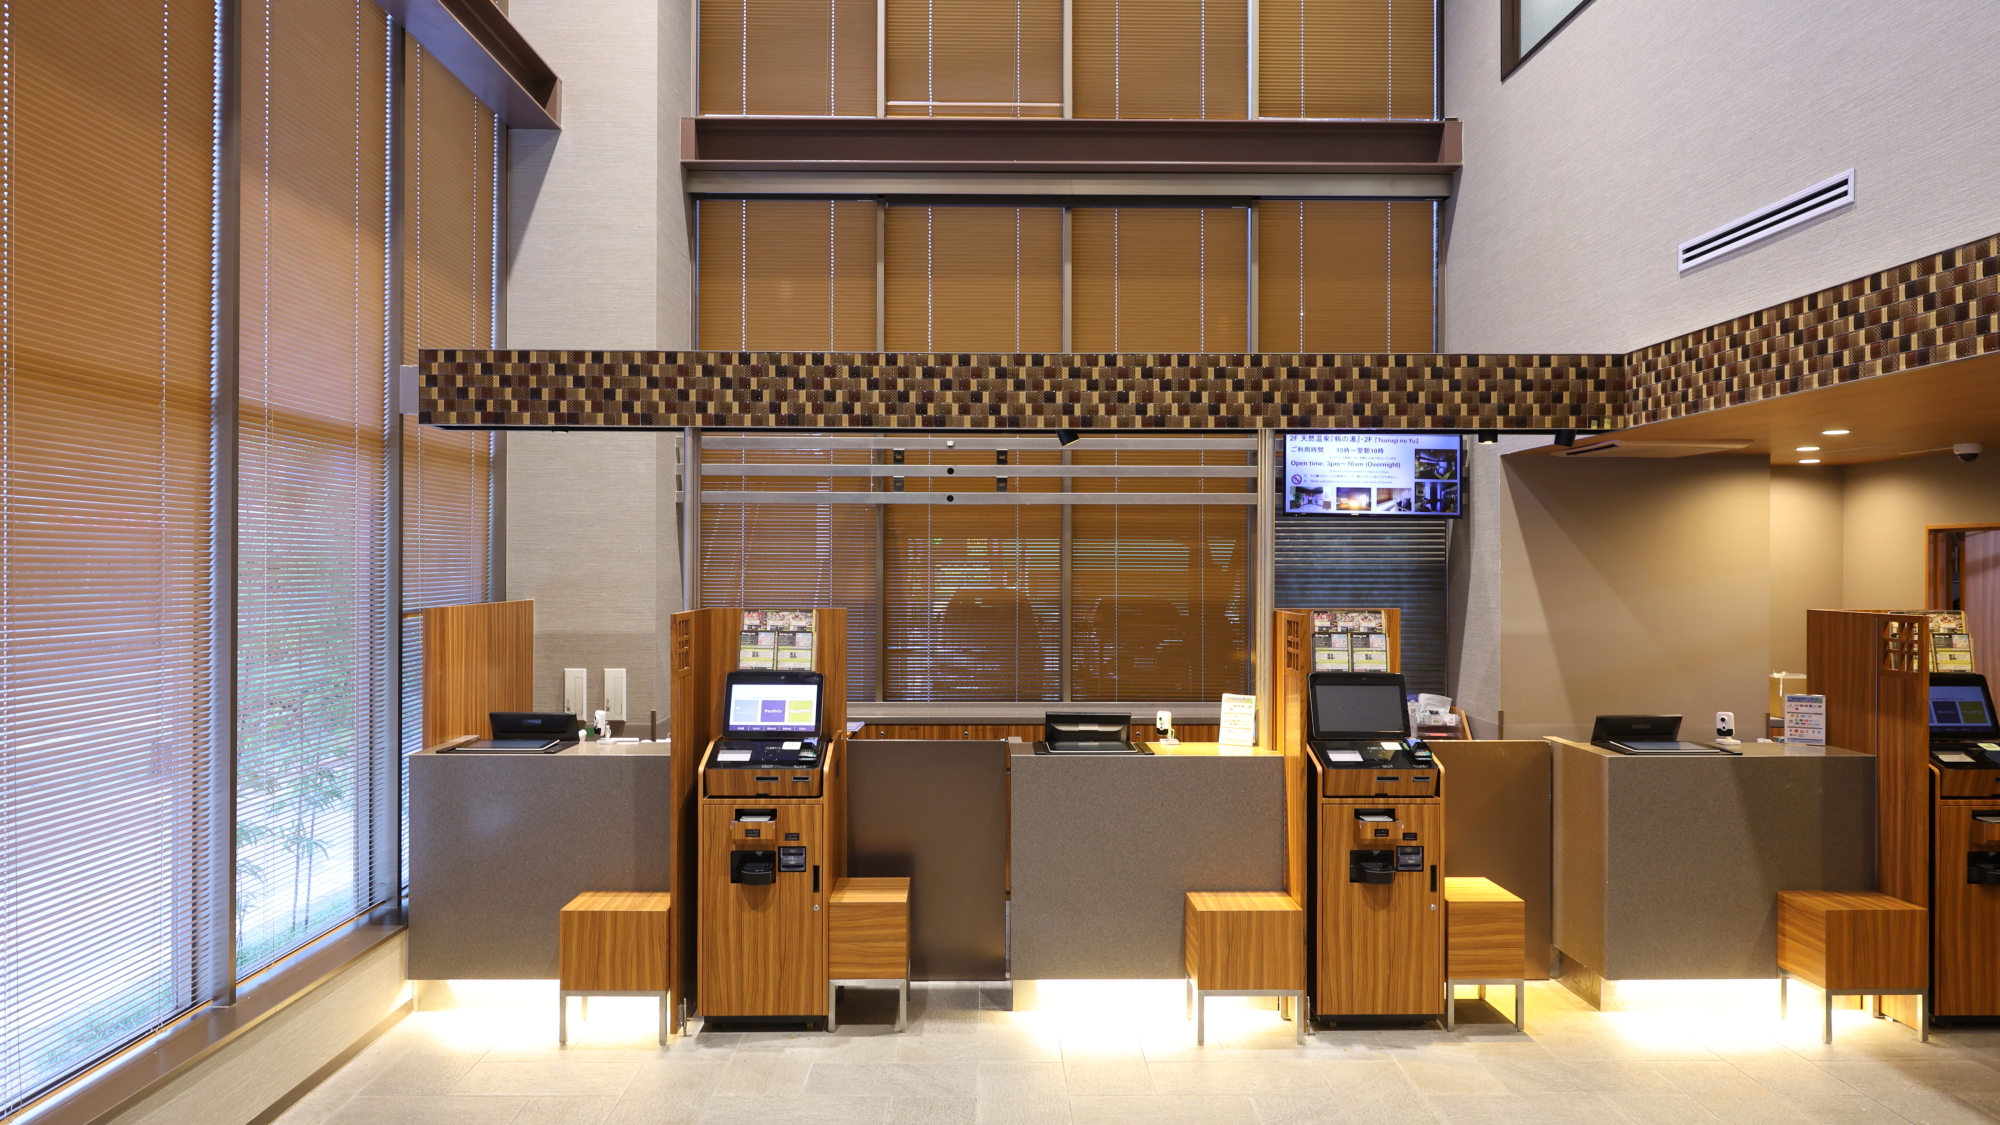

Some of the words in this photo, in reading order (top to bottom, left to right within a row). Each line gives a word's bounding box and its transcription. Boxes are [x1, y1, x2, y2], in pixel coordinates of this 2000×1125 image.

[1290, 446, 1325, 454] ご利用時間
[1365, 461, 1401, 469] (Overnight)
